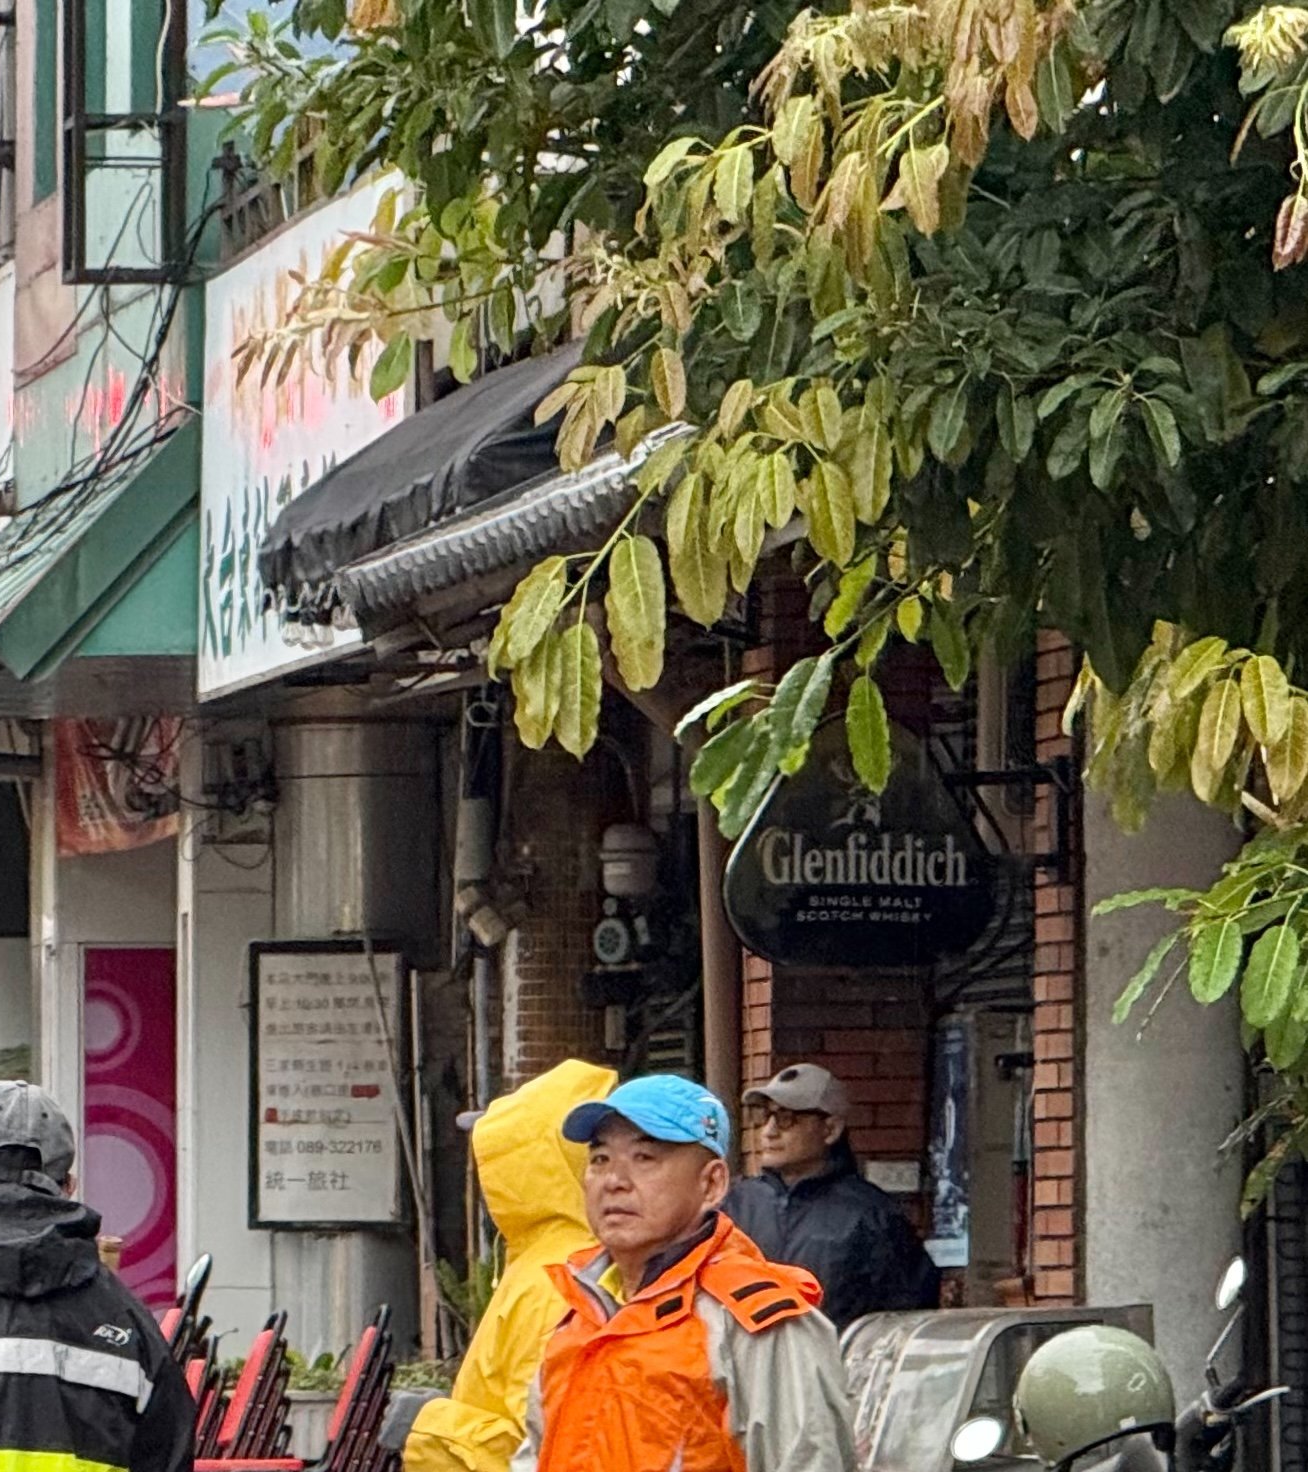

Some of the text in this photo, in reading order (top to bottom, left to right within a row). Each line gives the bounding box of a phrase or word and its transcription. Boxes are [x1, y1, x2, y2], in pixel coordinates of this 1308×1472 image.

[758, 826, 967, 887] Glenfiddich
[809, 896, 923, 908] SINGLE MALT
[796, 910, 864, 922] SCOTCH
